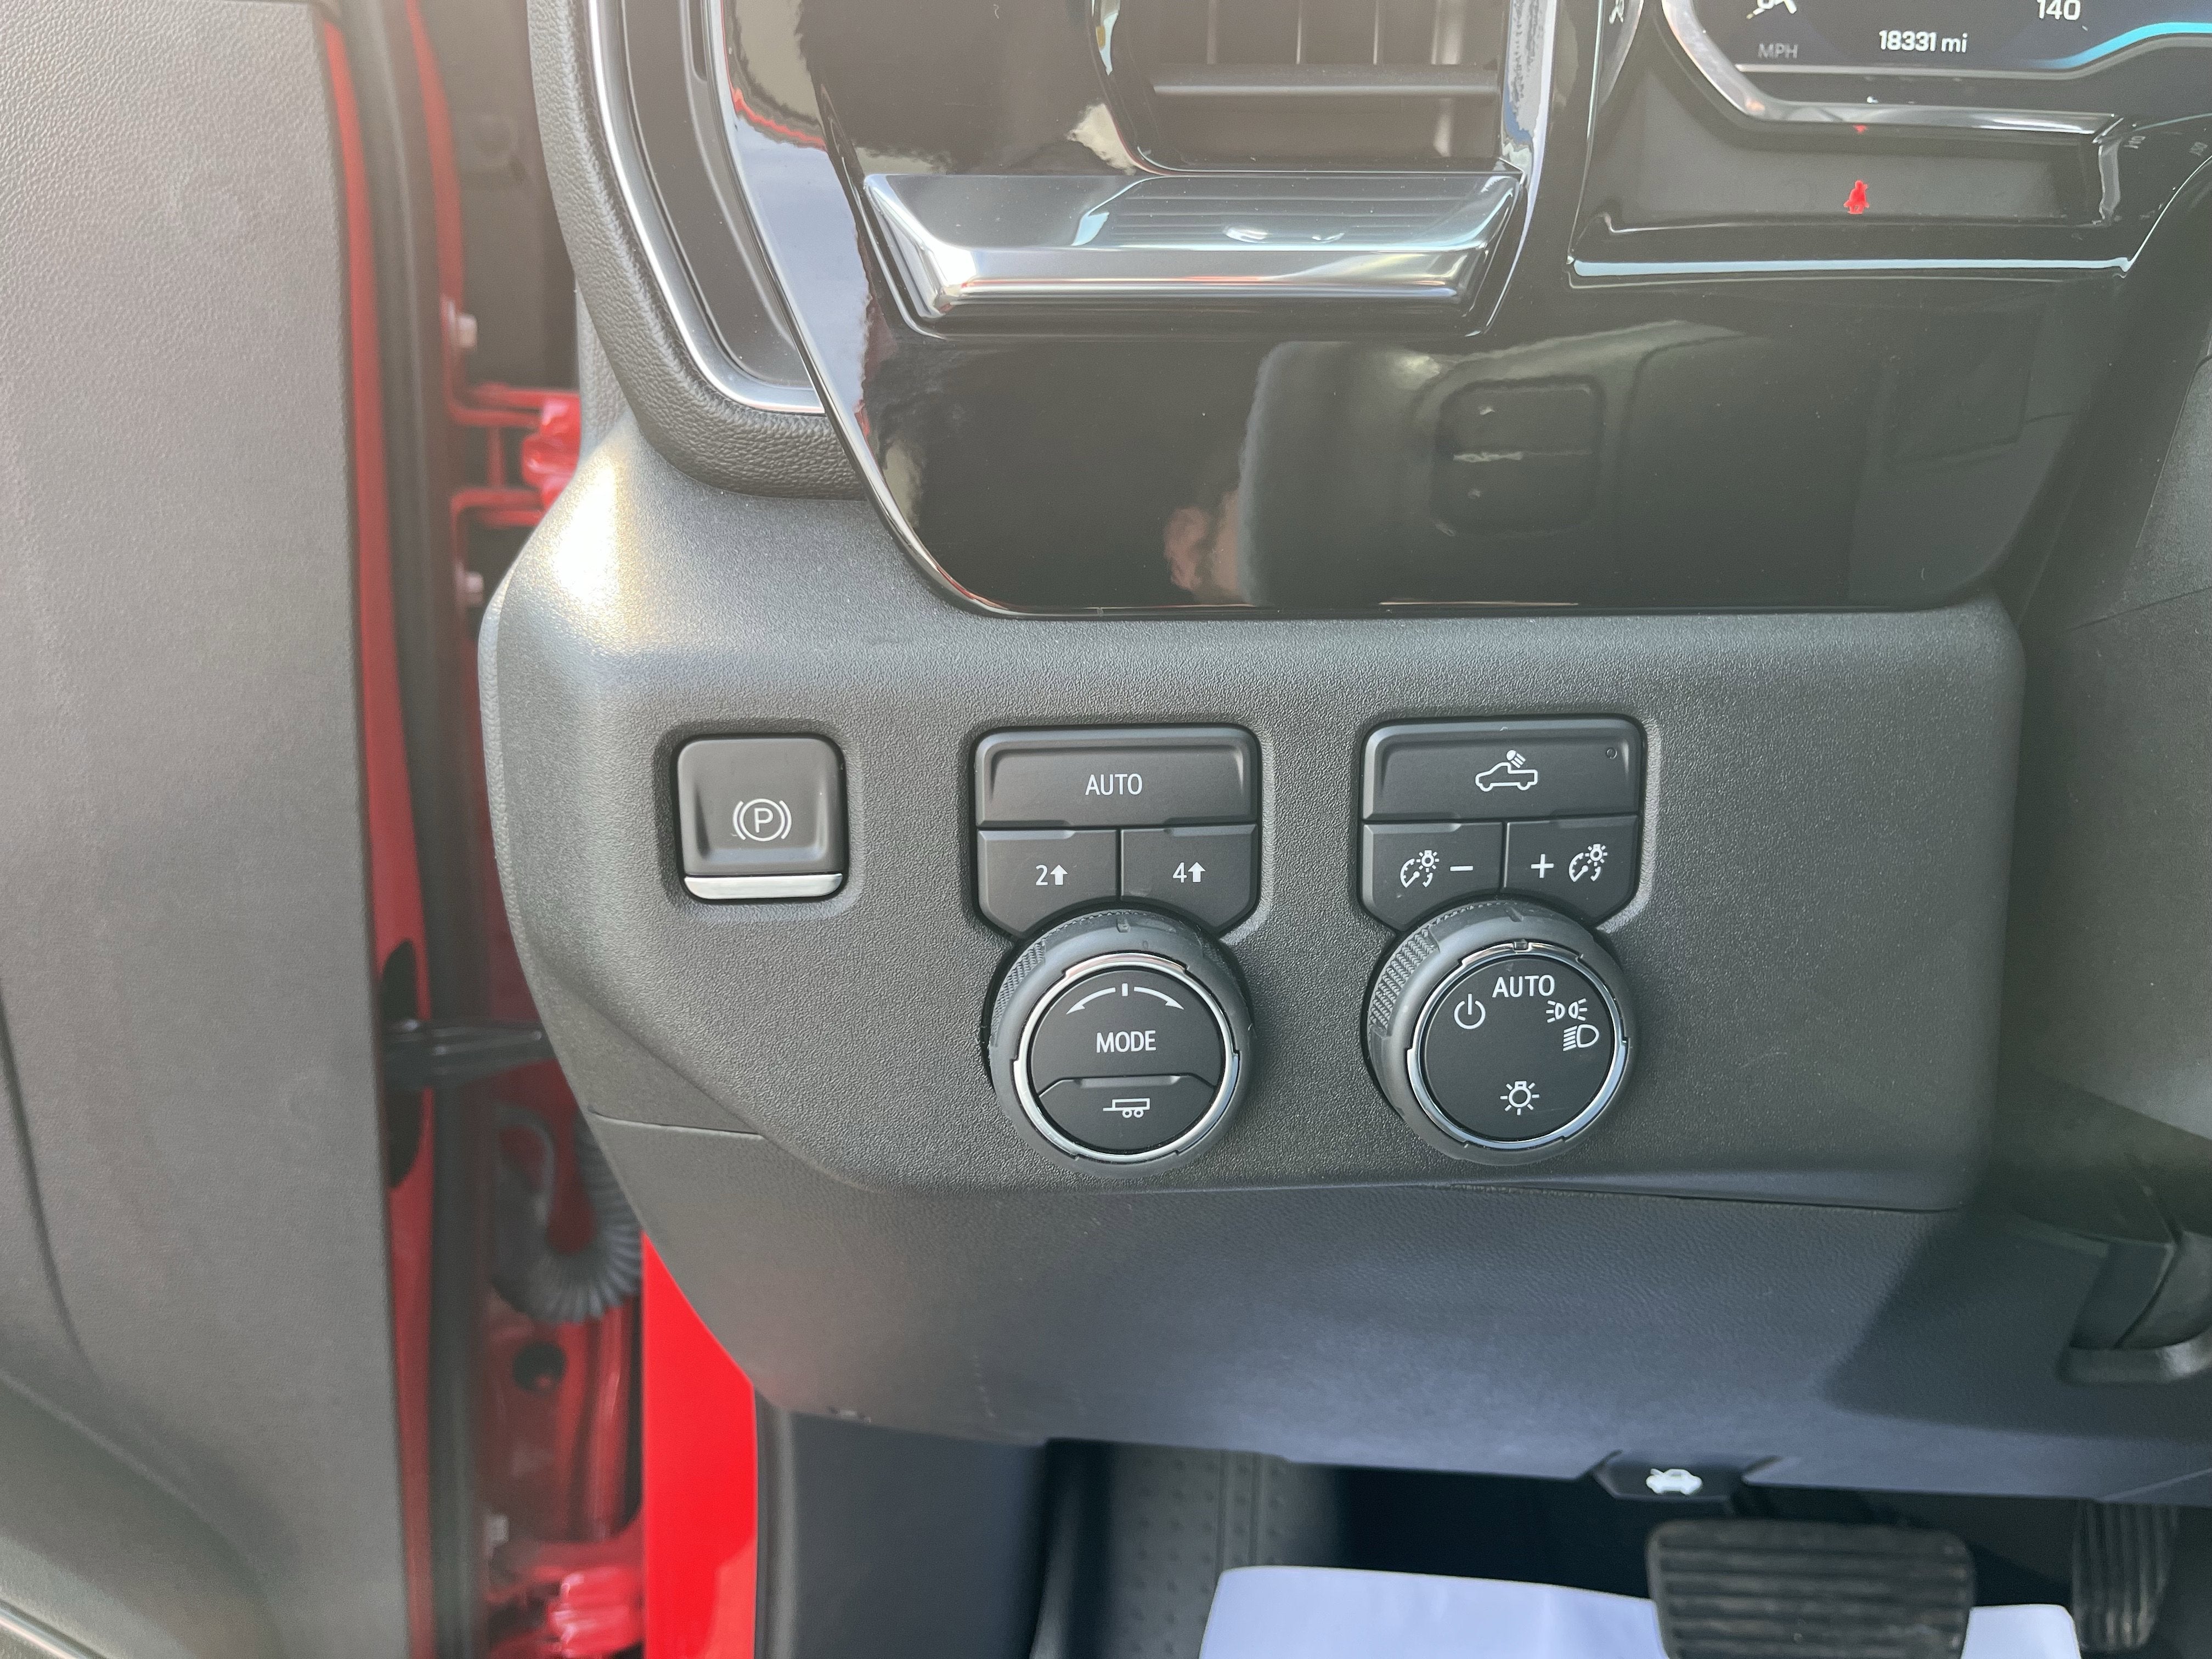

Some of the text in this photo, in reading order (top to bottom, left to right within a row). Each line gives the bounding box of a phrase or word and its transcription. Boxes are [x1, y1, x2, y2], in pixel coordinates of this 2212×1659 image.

[2037, 0, 2081, 20] 140
[1758, 43, 1798, 58] MPH
[1879, 30, 1968, 53] 18331 mi
[1085, 773, 1143, 795] AUTO
[1492, 975, 1555, 998] AUTO
[1097, 1030, 1156, 1053] MODE
